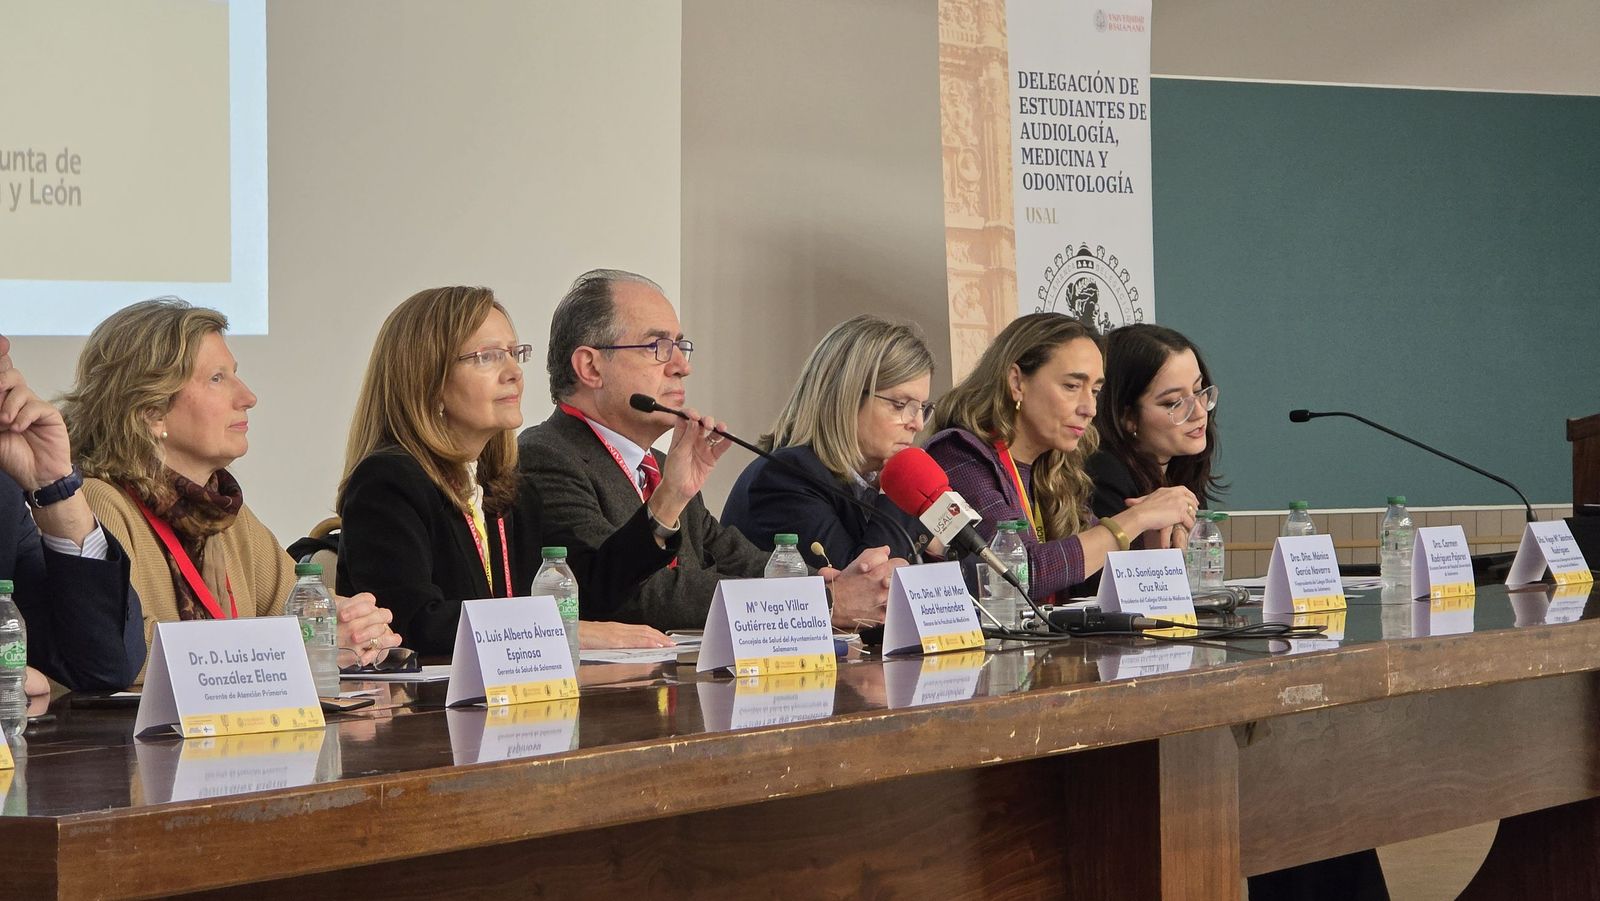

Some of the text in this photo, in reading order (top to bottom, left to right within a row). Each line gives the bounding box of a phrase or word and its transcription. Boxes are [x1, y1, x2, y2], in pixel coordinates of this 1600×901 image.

[1018, 70, 1139, 96] DELEGACIÓN DE
[1019, 96, 1147, 121] ESTUDIANTES DE
[1020, 120, 1119, 147] AUDIOLOGÍA,
[56, 146, 81, 175] de
[1021, 147, 1109, 169] MEDICINA Y
[1022, 170, 1134, 194] ODONTOLOGÍA
[9, 178, 81, 212] y León
[1025, 206, 1059, 224] USAL
[933, 515, 953, 533] USAL
[1312, 551, 1329, 561] Mónica
[1115, 566, 1183, 579] Dr. D. Santiago Santa
[1295, 566, 1331, 576] García Navarro
[909, 589, 923, 600] Dra.
[922, 588, 935, 599] Dña.
[943, 587, 952, 596] del
[952, 585, 964, 596] Mar
[1138, 581, 1168, 592] Cruz Ruiz
[760, 600, 784, 615] Vega
[785, 599, 808, 611] Villar
[921, 602, 965, 616] Abad Hernández
[475, 622, 564, 643] D. Luis Alberto Álvarez
[734, 616, 827, 632] Gutiérrez de Ceballos
[738, 638, 762, 646] Concejala
[769, 636, 782, 644] Salud
[790, 634, 822, 644] Ayuntamiento
[189, 648, 286, 666] Dr. D. Luis Javier
[506, 648, 541, 663] Espinosa
[198, 669, 287, 687] González Elena
[497, 668, 514, 676] Gerente
[539, 664, 562, 672] Salamanca
[204, 689, 288, 701] Gerente de Atención Primaria
